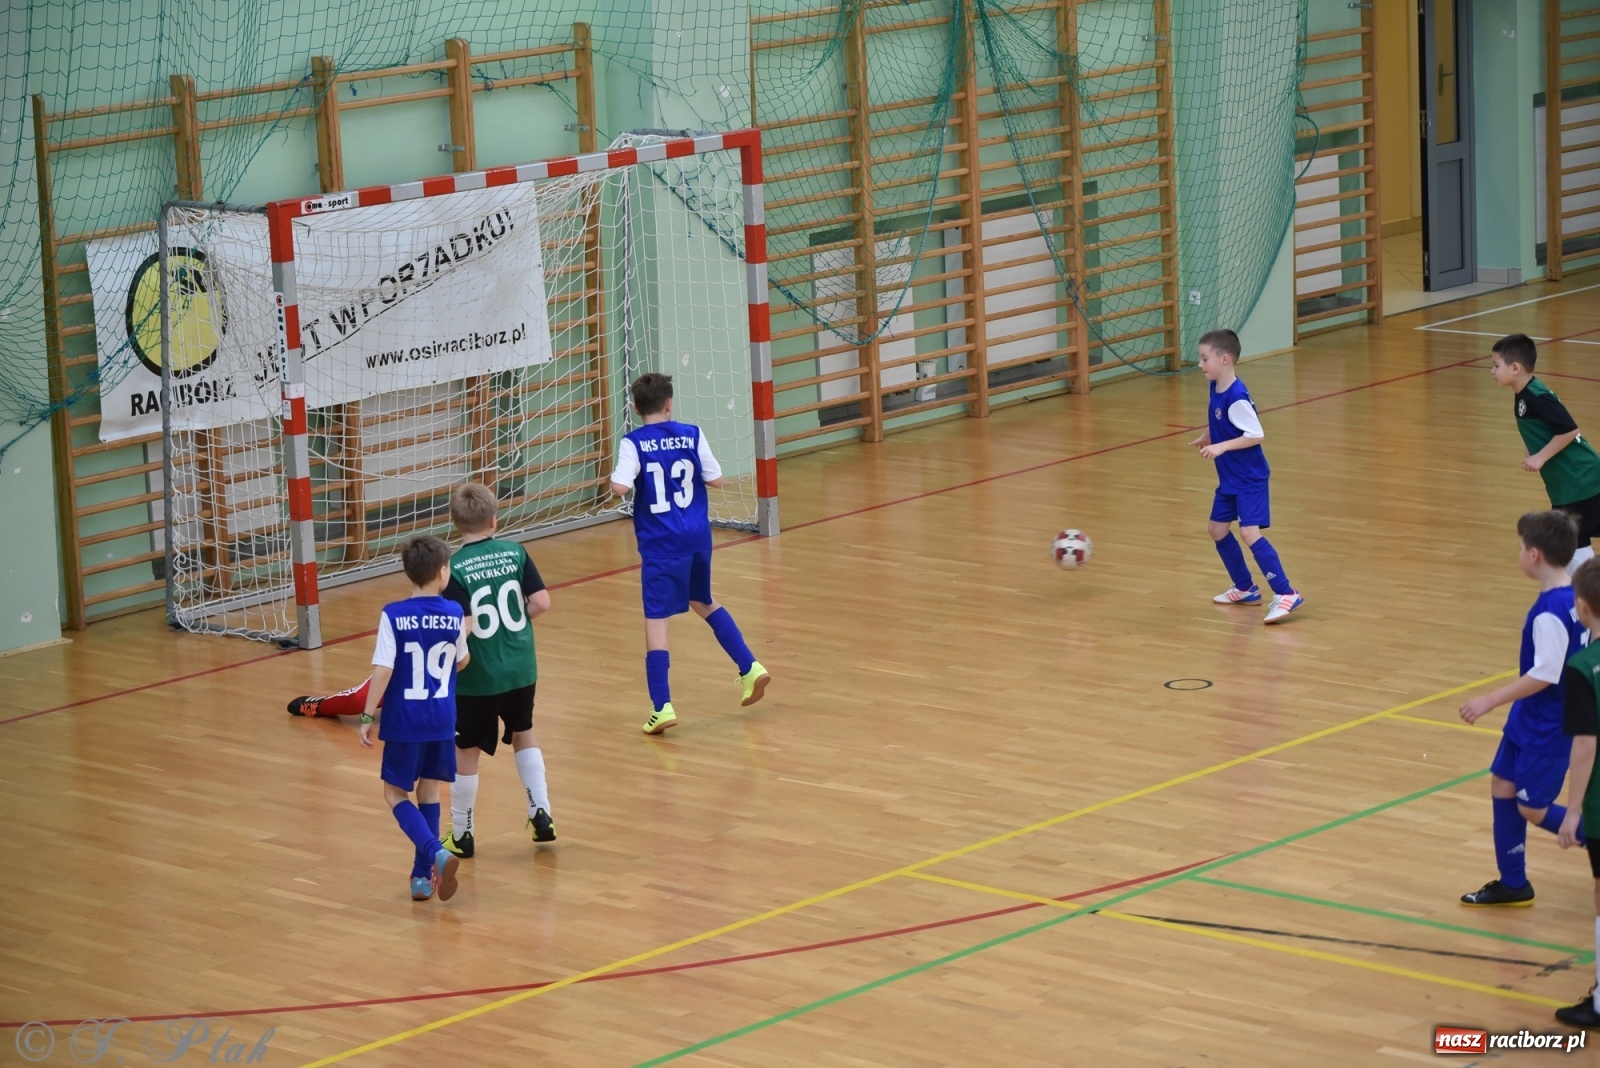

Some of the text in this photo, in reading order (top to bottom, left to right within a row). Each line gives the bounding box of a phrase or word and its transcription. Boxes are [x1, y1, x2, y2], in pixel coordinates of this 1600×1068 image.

[328, 196, 348, 209] sport
[328, 301, 357, 336] W
[640, 438, 659, 453] UKS
[646, 458, 695, 514] 13
[464, 563, 519, 584] TWORKÓW
[395, 615, 419, 631] UKS
[470, 579, 527, 640] 60
[403, 641, 457, 700] 19
